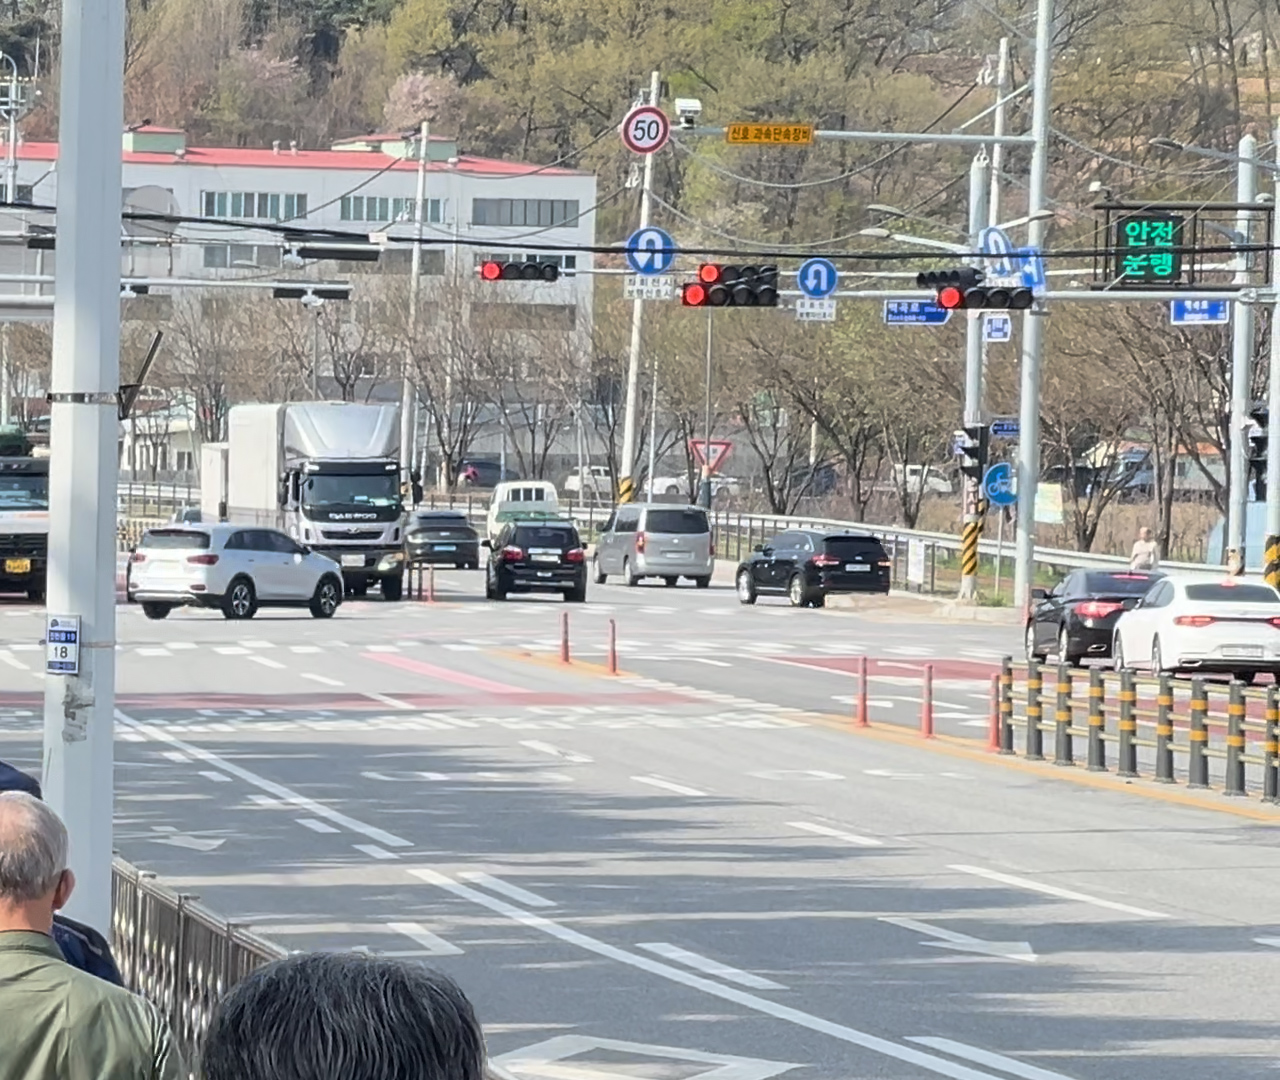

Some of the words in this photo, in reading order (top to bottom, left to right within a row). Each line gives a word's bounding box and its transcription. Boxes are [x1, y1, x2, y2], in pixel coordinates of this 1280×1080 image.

[633, 120, 659, 141] 50
[1125, 221, 1173, 246] 안전
[1122, 253, 1172, 275] 운행
[328, 512, 377, 520] DAEWOO
[54, 645, 68, 659] 18
